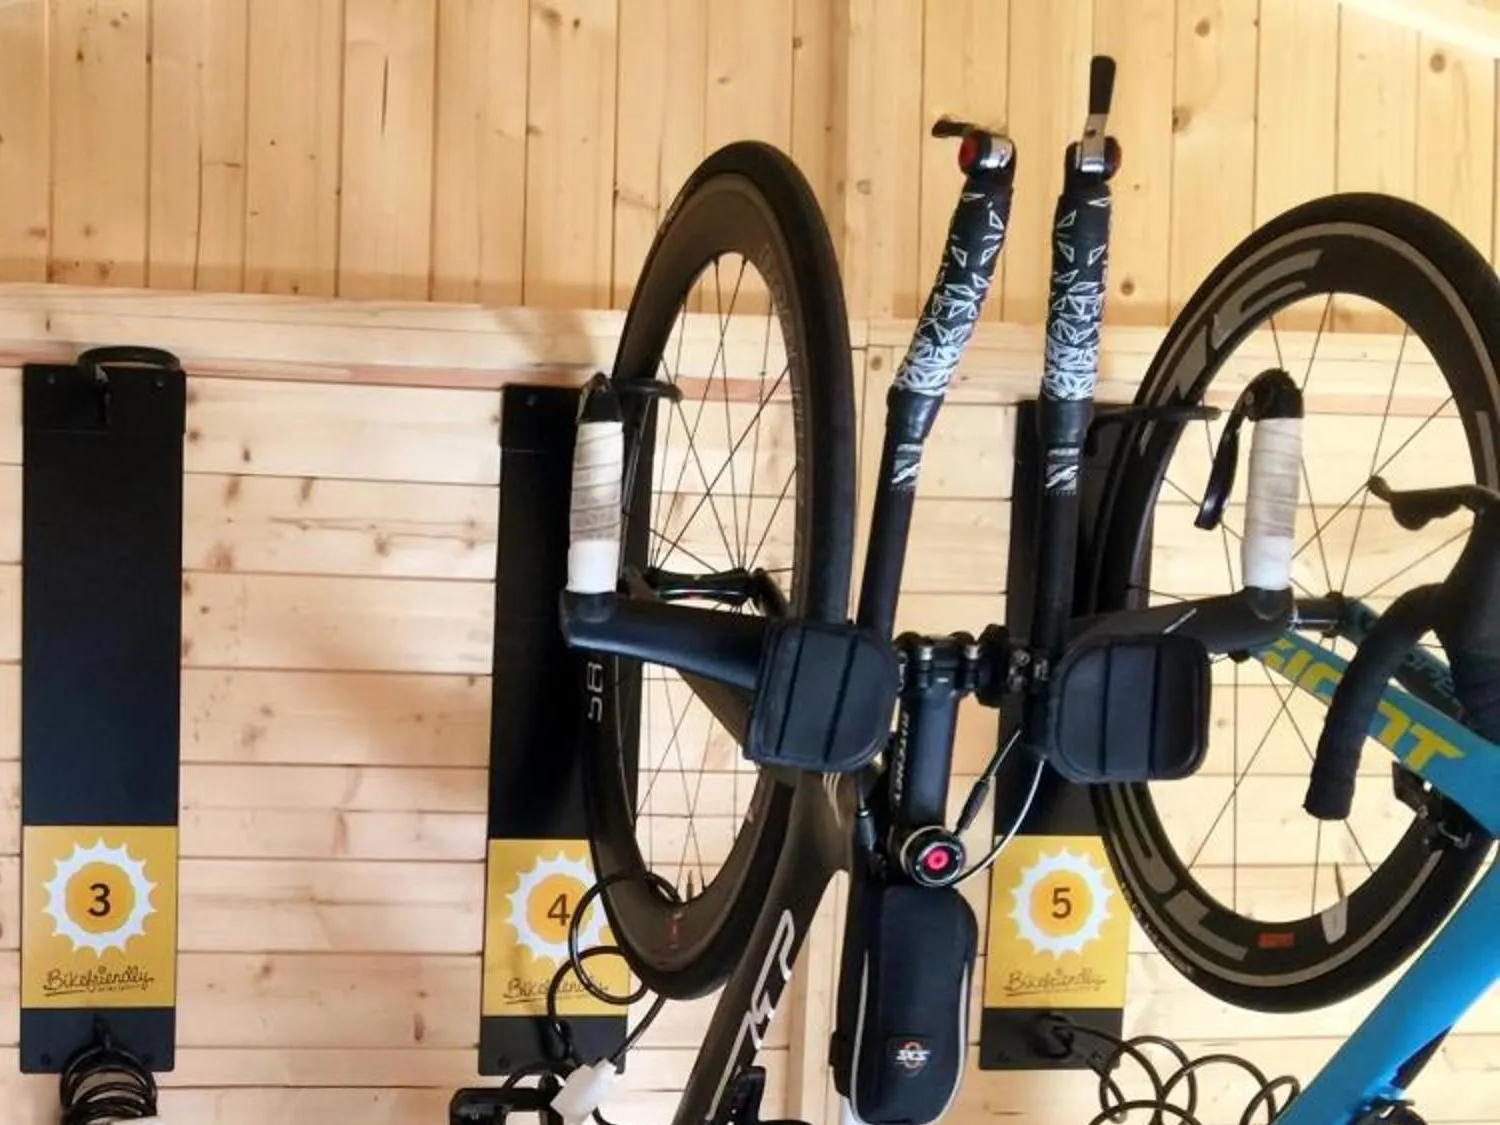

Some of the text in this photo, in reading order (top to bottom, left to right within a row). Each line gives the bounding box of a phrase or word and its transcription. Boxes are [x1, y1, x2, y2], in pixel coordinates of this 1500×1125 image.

[87, 882, 111, 918] 3
[547, 892, 570, 927] 4
[1051, 886, 1073, 920] 5
[43, 965, 156, 994] Bikefriendly
